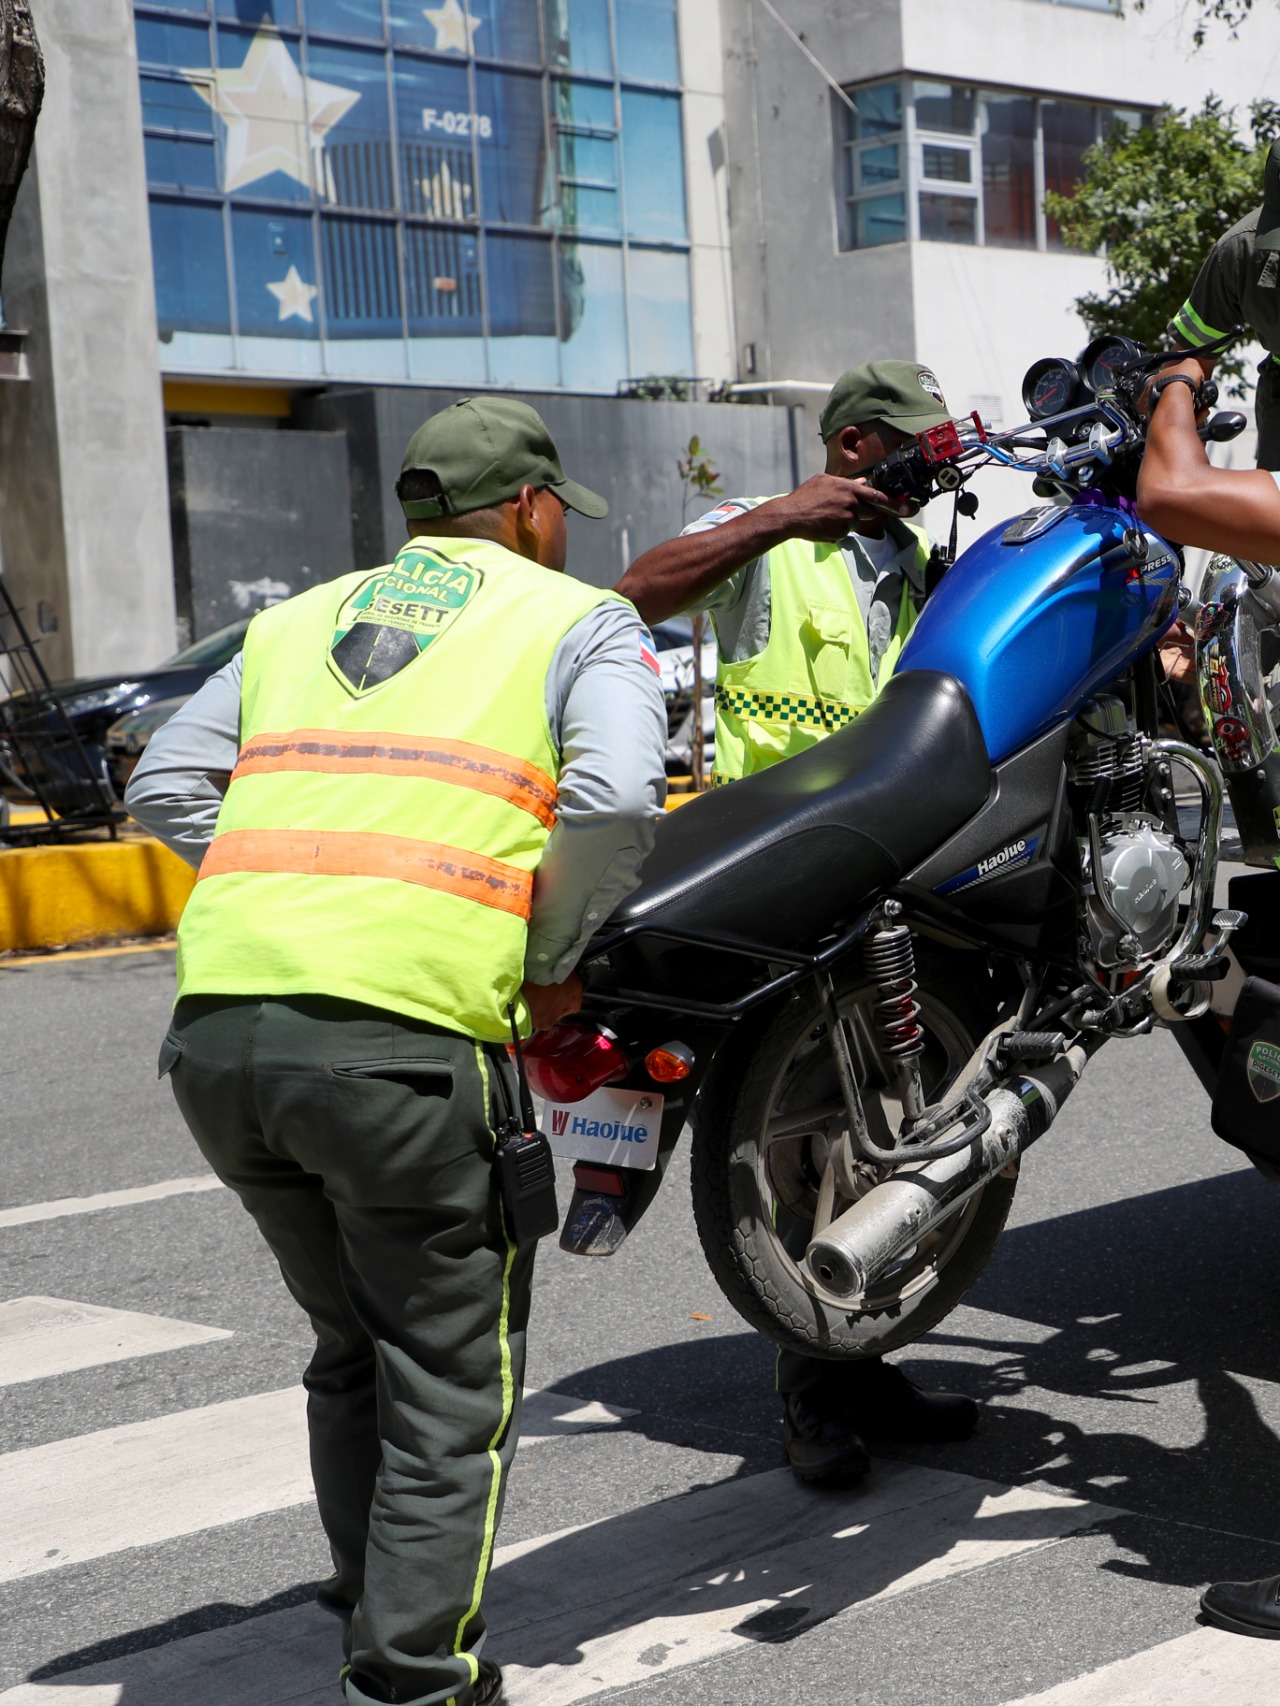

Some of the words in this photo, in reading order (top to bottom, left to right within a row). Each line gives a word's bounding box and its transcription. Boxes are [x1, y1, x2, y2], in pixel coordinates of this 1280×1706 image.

[422, 107, 492, 138] F-0278
[383, 574, 450, 603] CIONAL
[977, 839, 1027, 876] Haojue
[572, 1116, 648, 1144] Haojue
